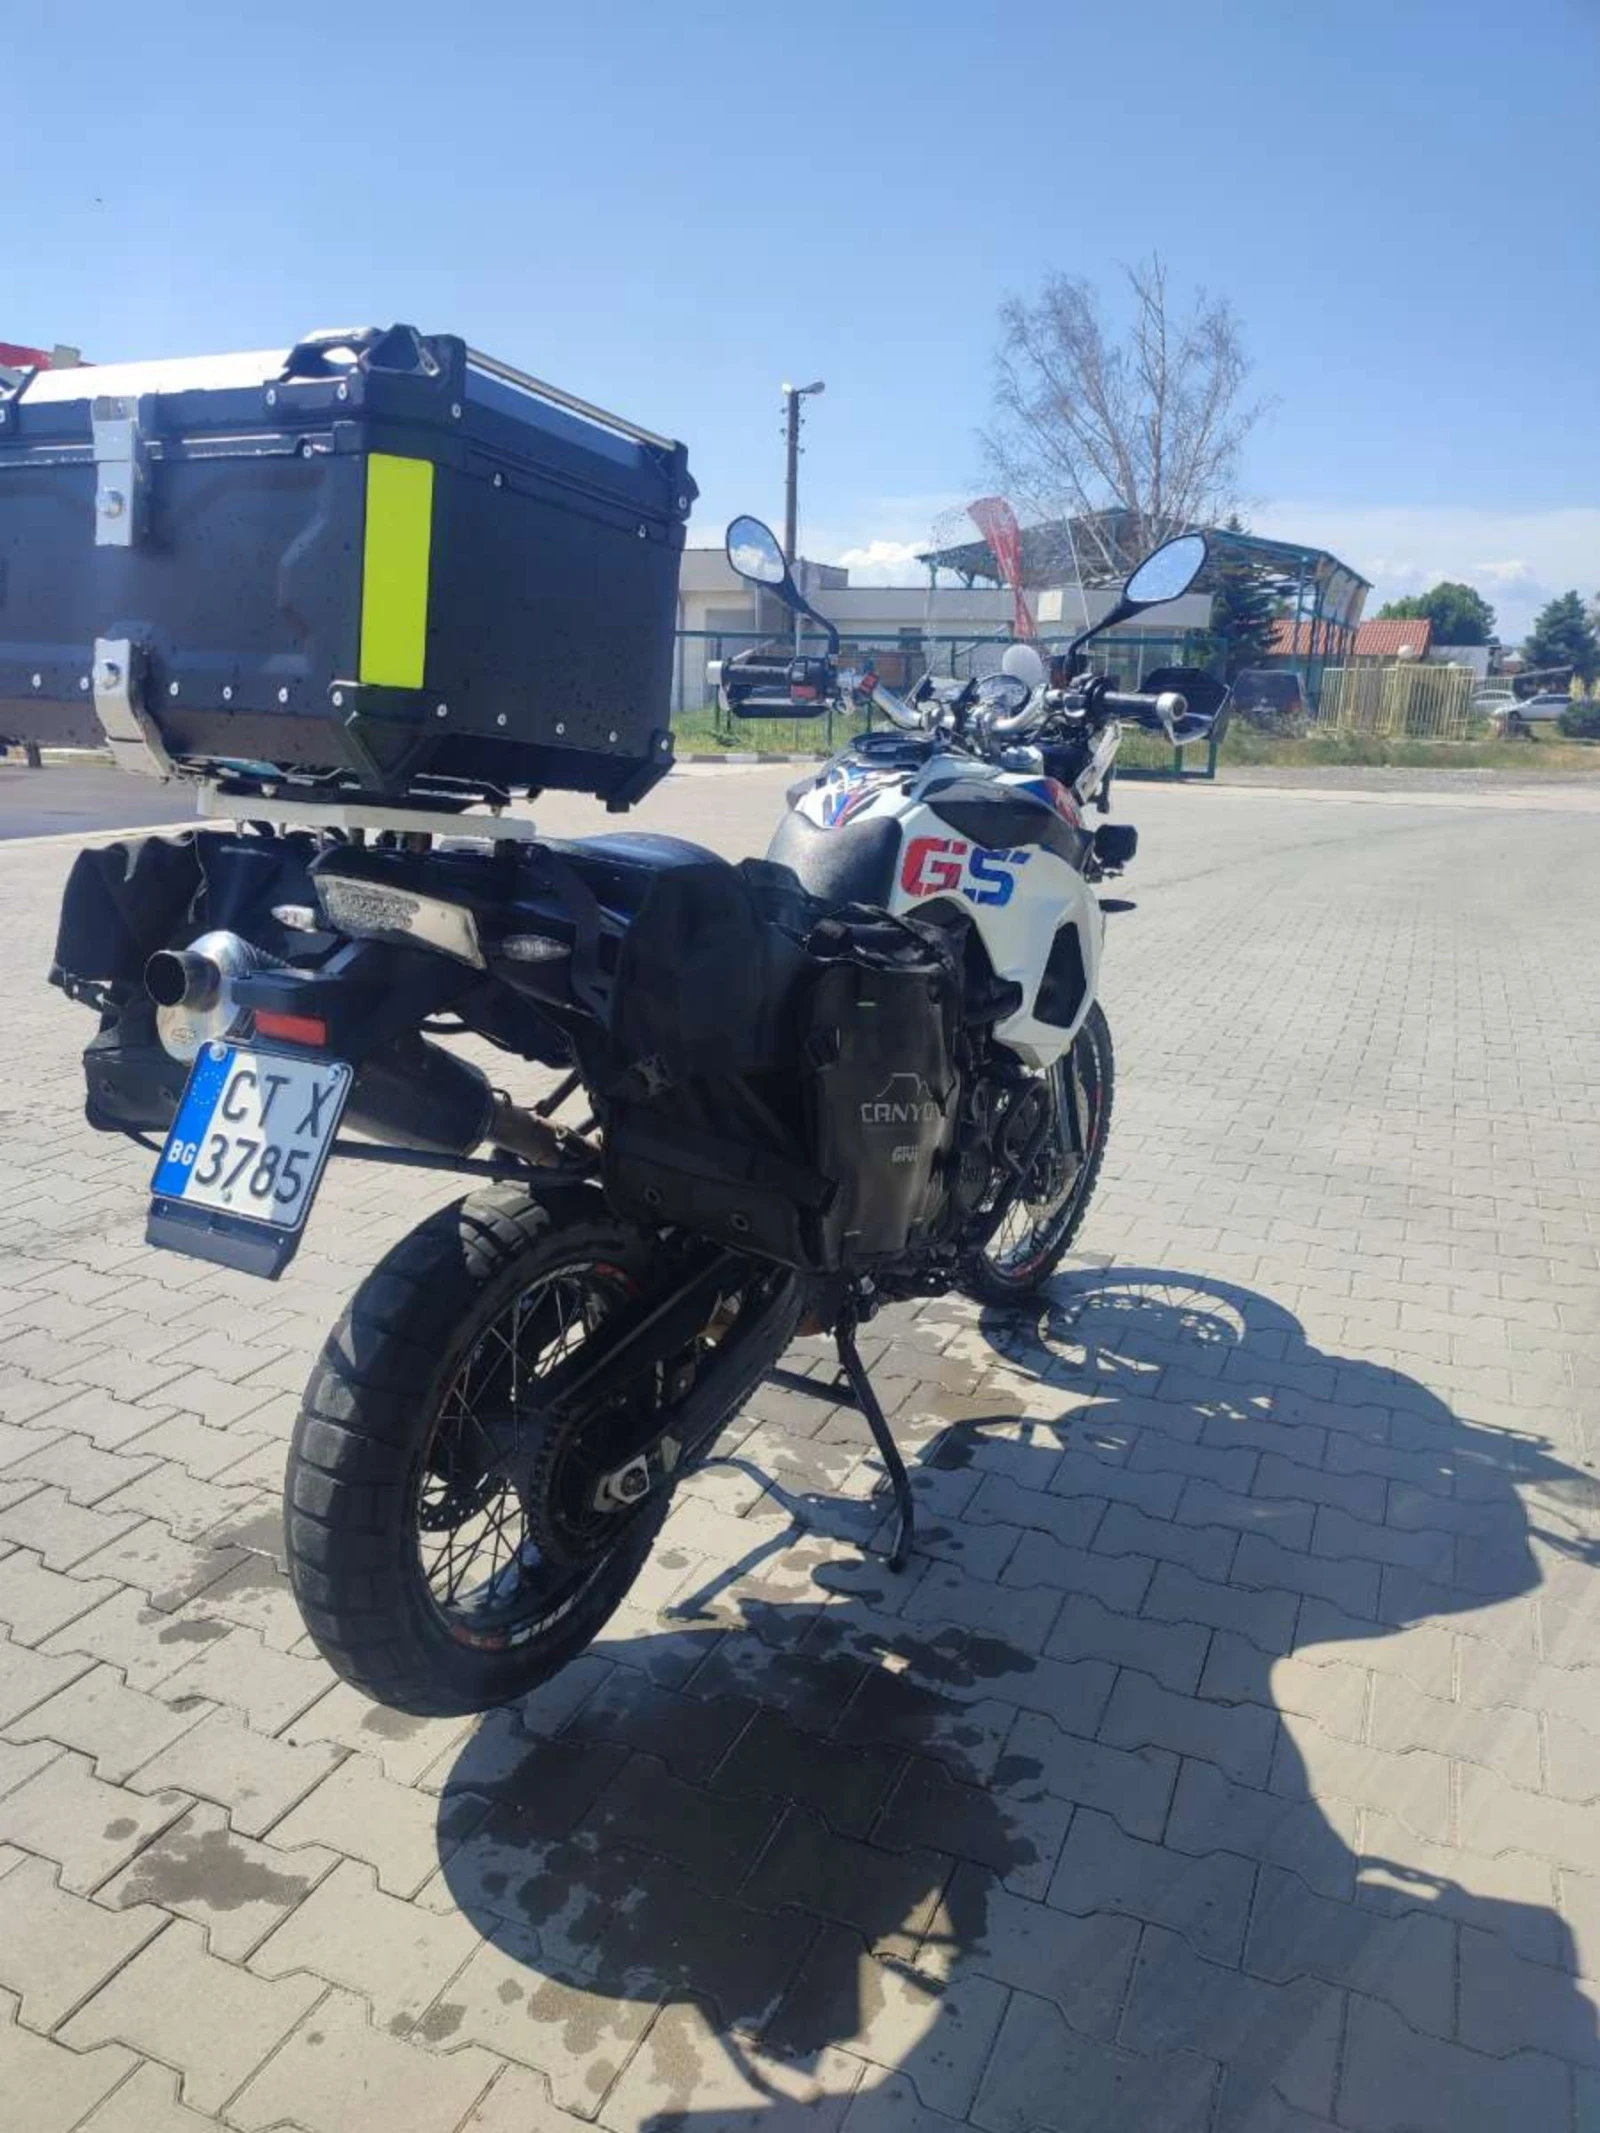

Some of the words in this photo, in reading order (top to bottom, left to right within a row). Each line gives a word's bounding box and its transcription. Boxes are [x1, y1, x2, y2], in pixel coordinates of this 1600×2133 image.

[900, 836, 1033, 908] GS
[222, 1069, 291, 1128] CT
[295, 1081, 335, 1138] X
[167, 1138, 197, 1166] BG
[194, 1132, 310, 1204] 3785
